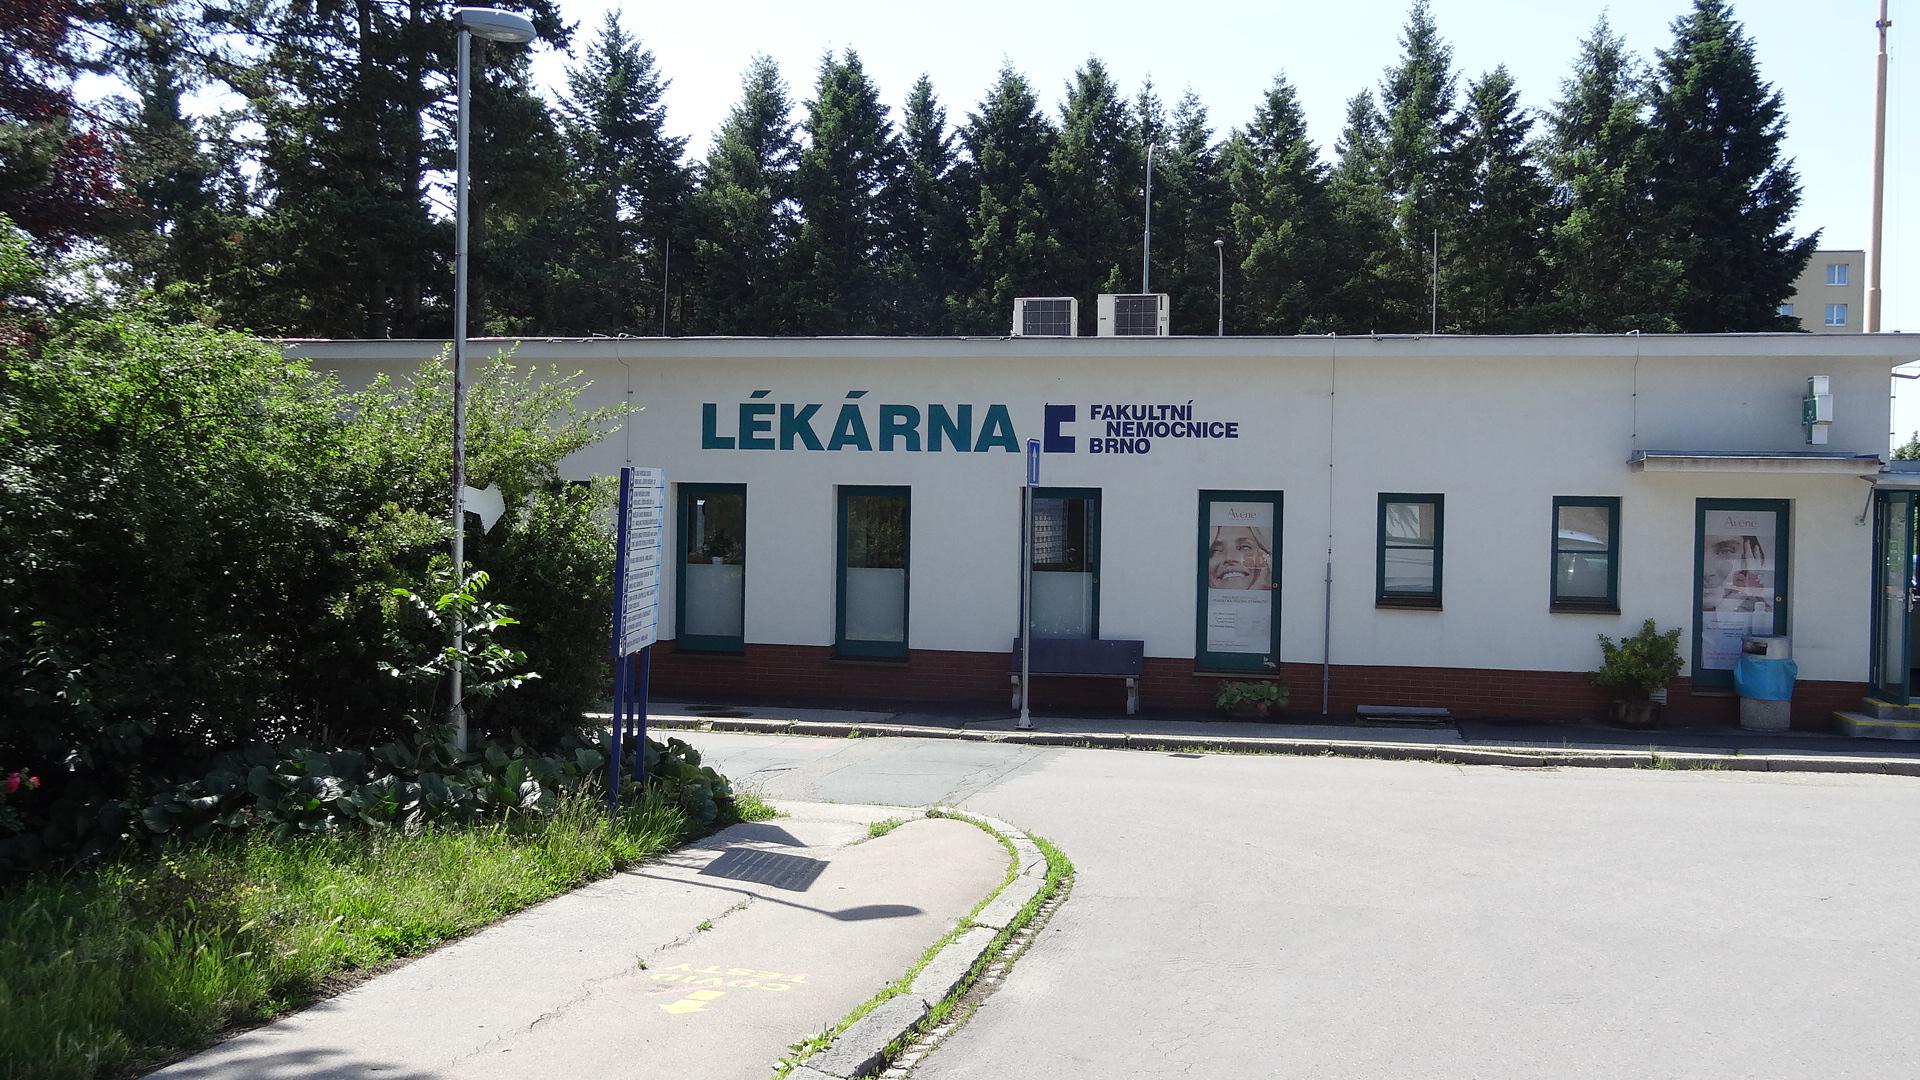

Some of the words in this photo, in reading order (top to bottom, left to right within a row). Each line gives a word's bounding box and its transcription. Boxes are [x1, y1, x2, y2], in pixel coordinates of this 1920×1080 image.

[1090, 400, 1193, 421] FAKULTNÍ
[701, 390, 1021, 452] LÉKÁRNA
[1106, 421, 1238, 438] NEMOCNICE
[1089, 437, 1150, 453] BRNO
